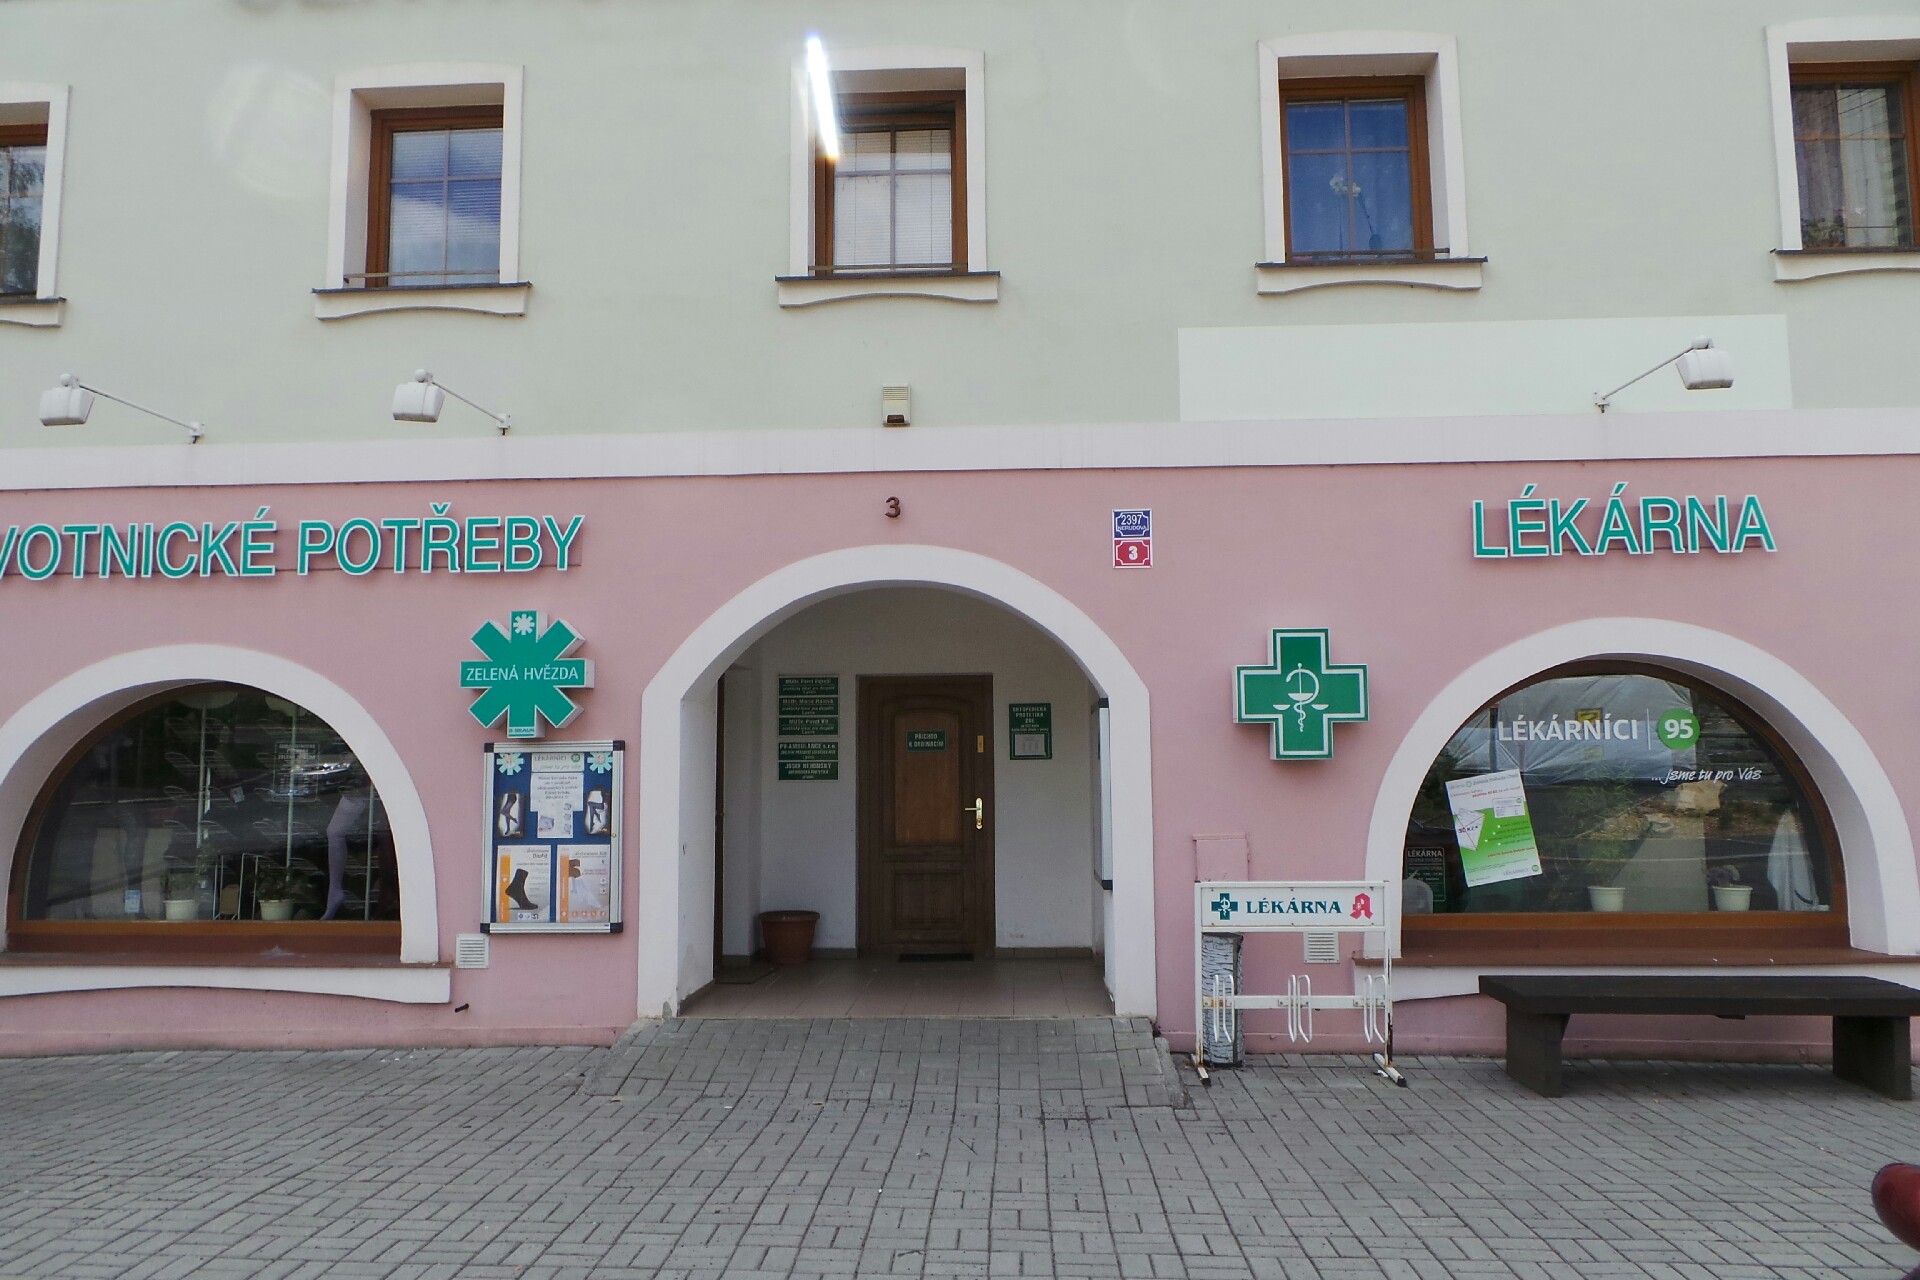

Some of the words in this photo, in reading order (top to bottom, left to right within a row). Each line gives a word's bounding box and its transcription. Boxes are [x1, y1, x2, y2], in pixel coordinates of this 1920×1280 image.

[885, 496, 900, 518] 3
[1121, 514, 1142, 525] 2397
[1472, 482, 1778, 558] LÉKÁRNA
[297, 502, 585, 576] POTŘEBY
[1128, 545, 1138, 560] 3
[466, 664, 519, 681] ZELENÁ
[525, 663, 579, 680] HVĚZDA
[1497, 715, 1638, 742] LÉKÁRNÍCI
[1664, 718, 1694, 740] 95
[1698, 769, 1713, 781] tu
[1714, 771, 1734, 784] pro
[1738, 766, 1762, 781] Vás
[1407, 849, 1443, 857] LÉKÁRNA
[1246, 897, 1342, 914] LÉKÁRNA
